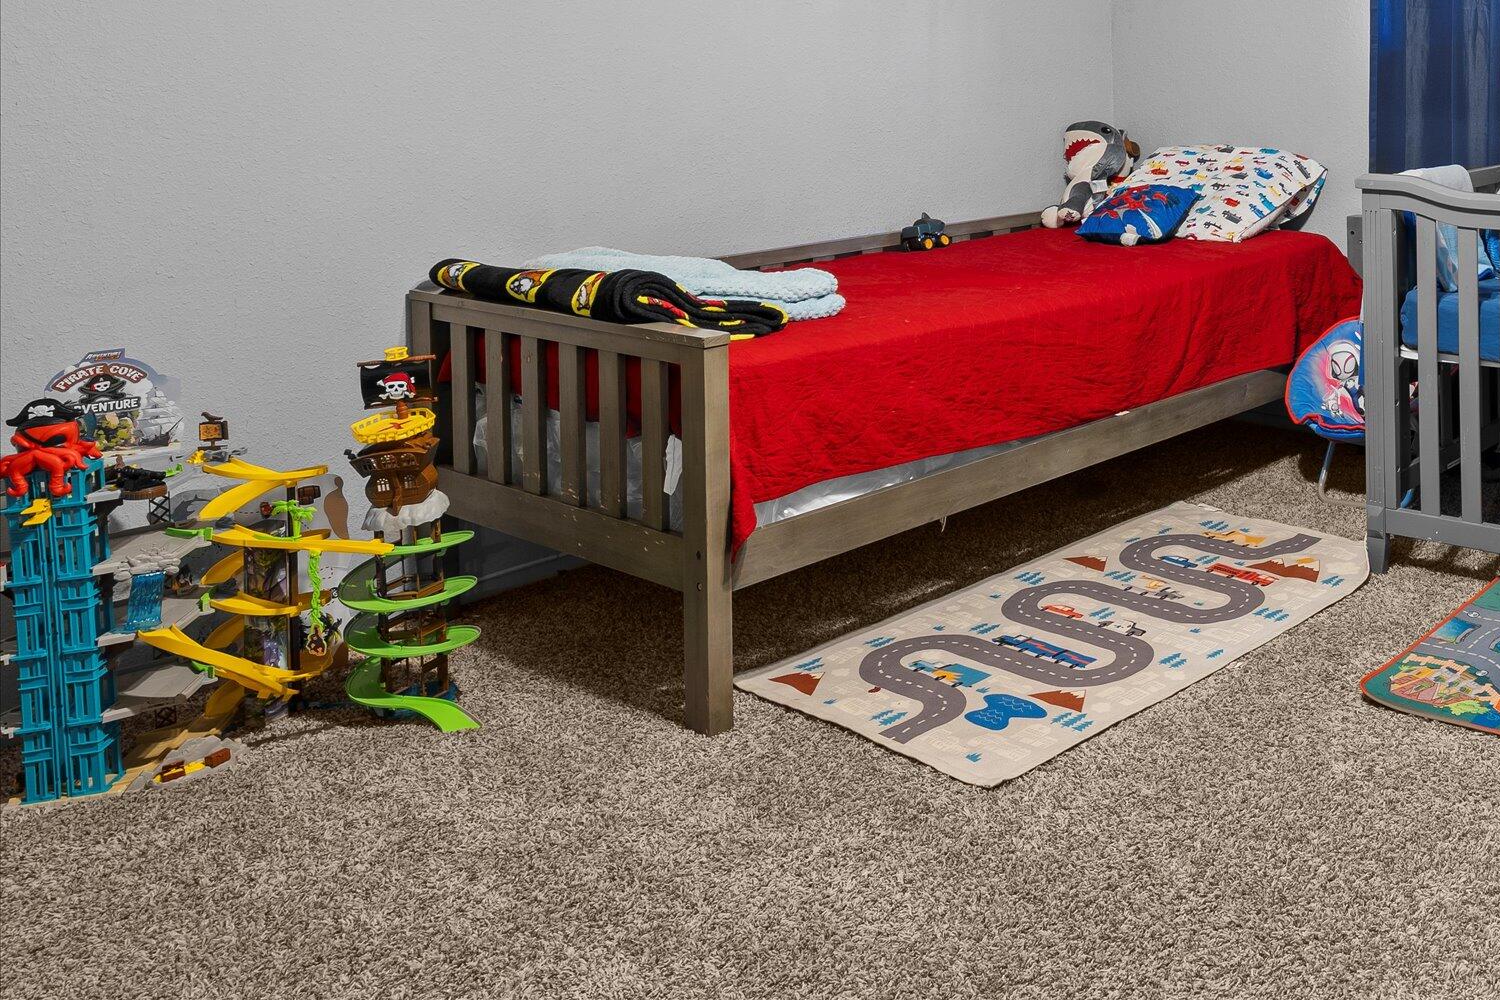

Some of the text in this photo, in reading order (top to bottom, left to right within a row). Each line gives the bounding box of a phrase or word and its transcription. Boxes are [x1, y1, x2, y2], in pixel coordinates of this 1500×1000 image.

[55, 365, 144, 390] PIRATE COVE
[73, 398, 139, 414] VENTURE
